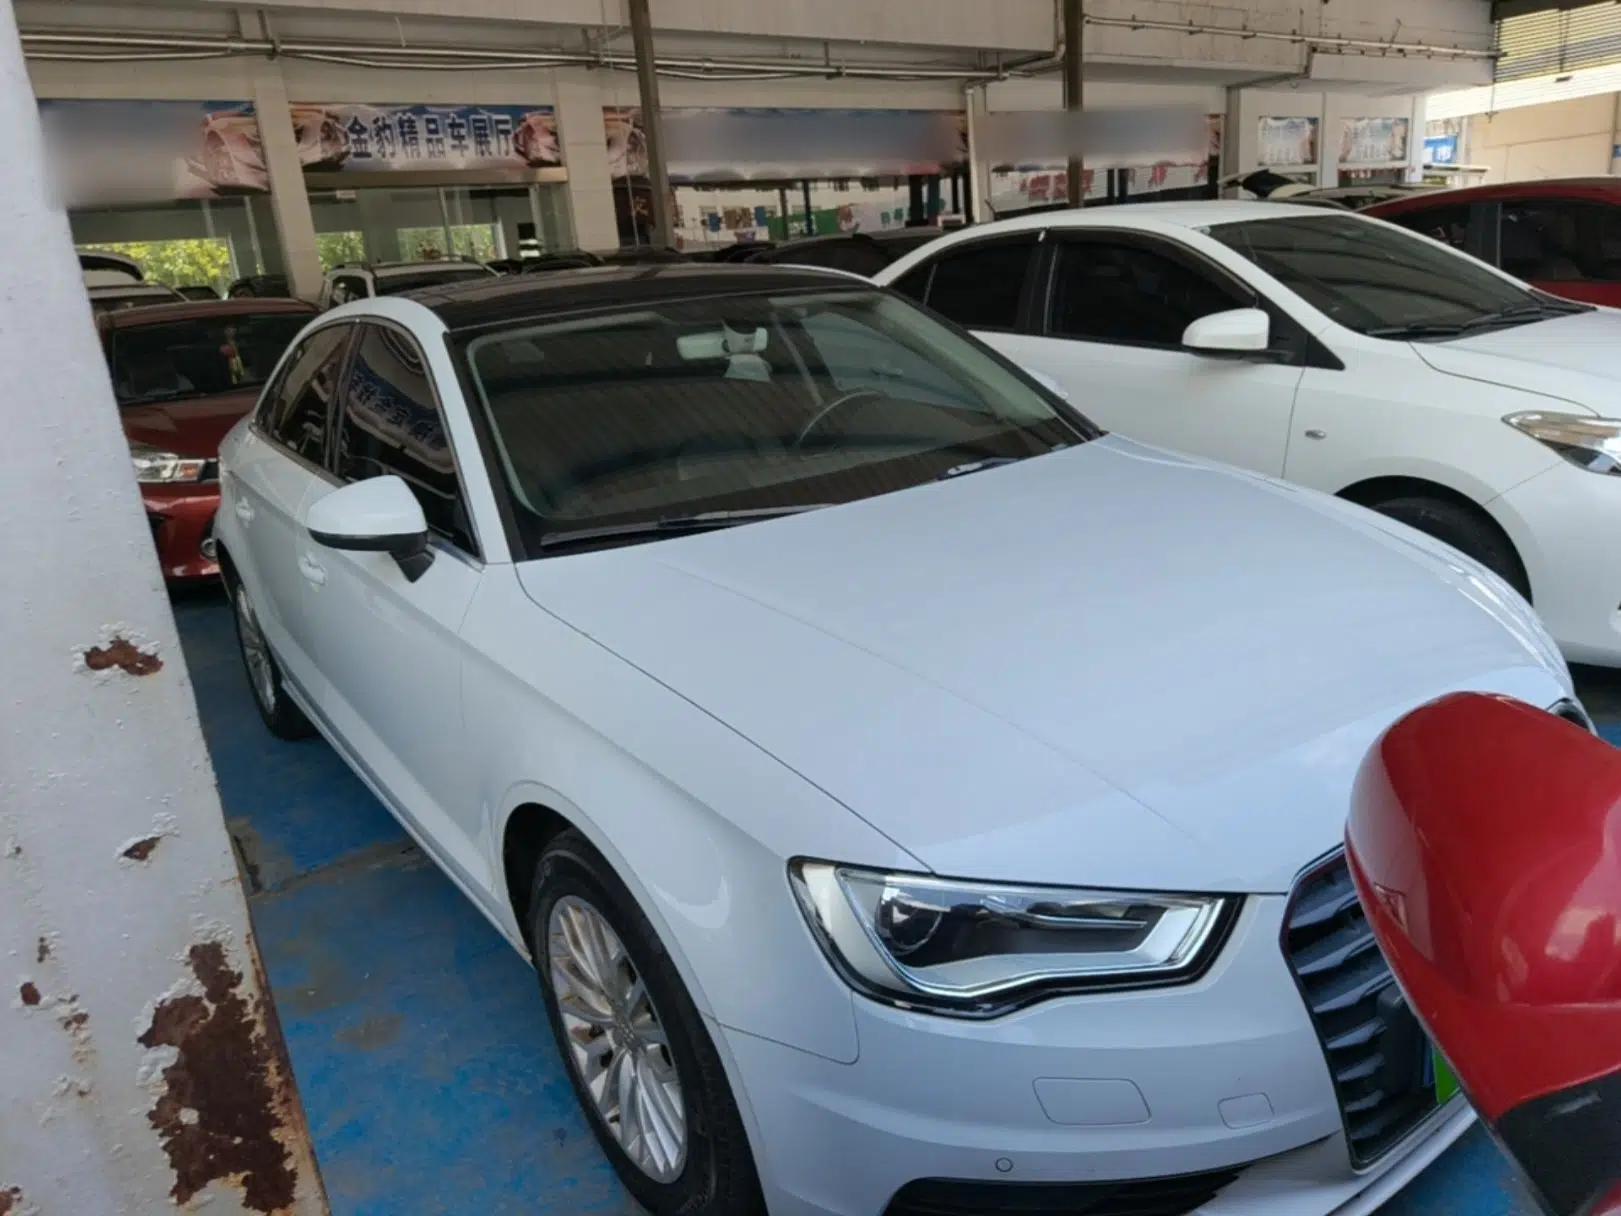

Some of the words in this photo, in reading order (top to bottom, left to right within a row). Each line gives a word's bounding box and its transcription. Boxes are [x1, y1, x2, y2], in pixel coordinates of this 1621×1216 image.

[346, 113, 513, 159] 金豹精品车展厅
